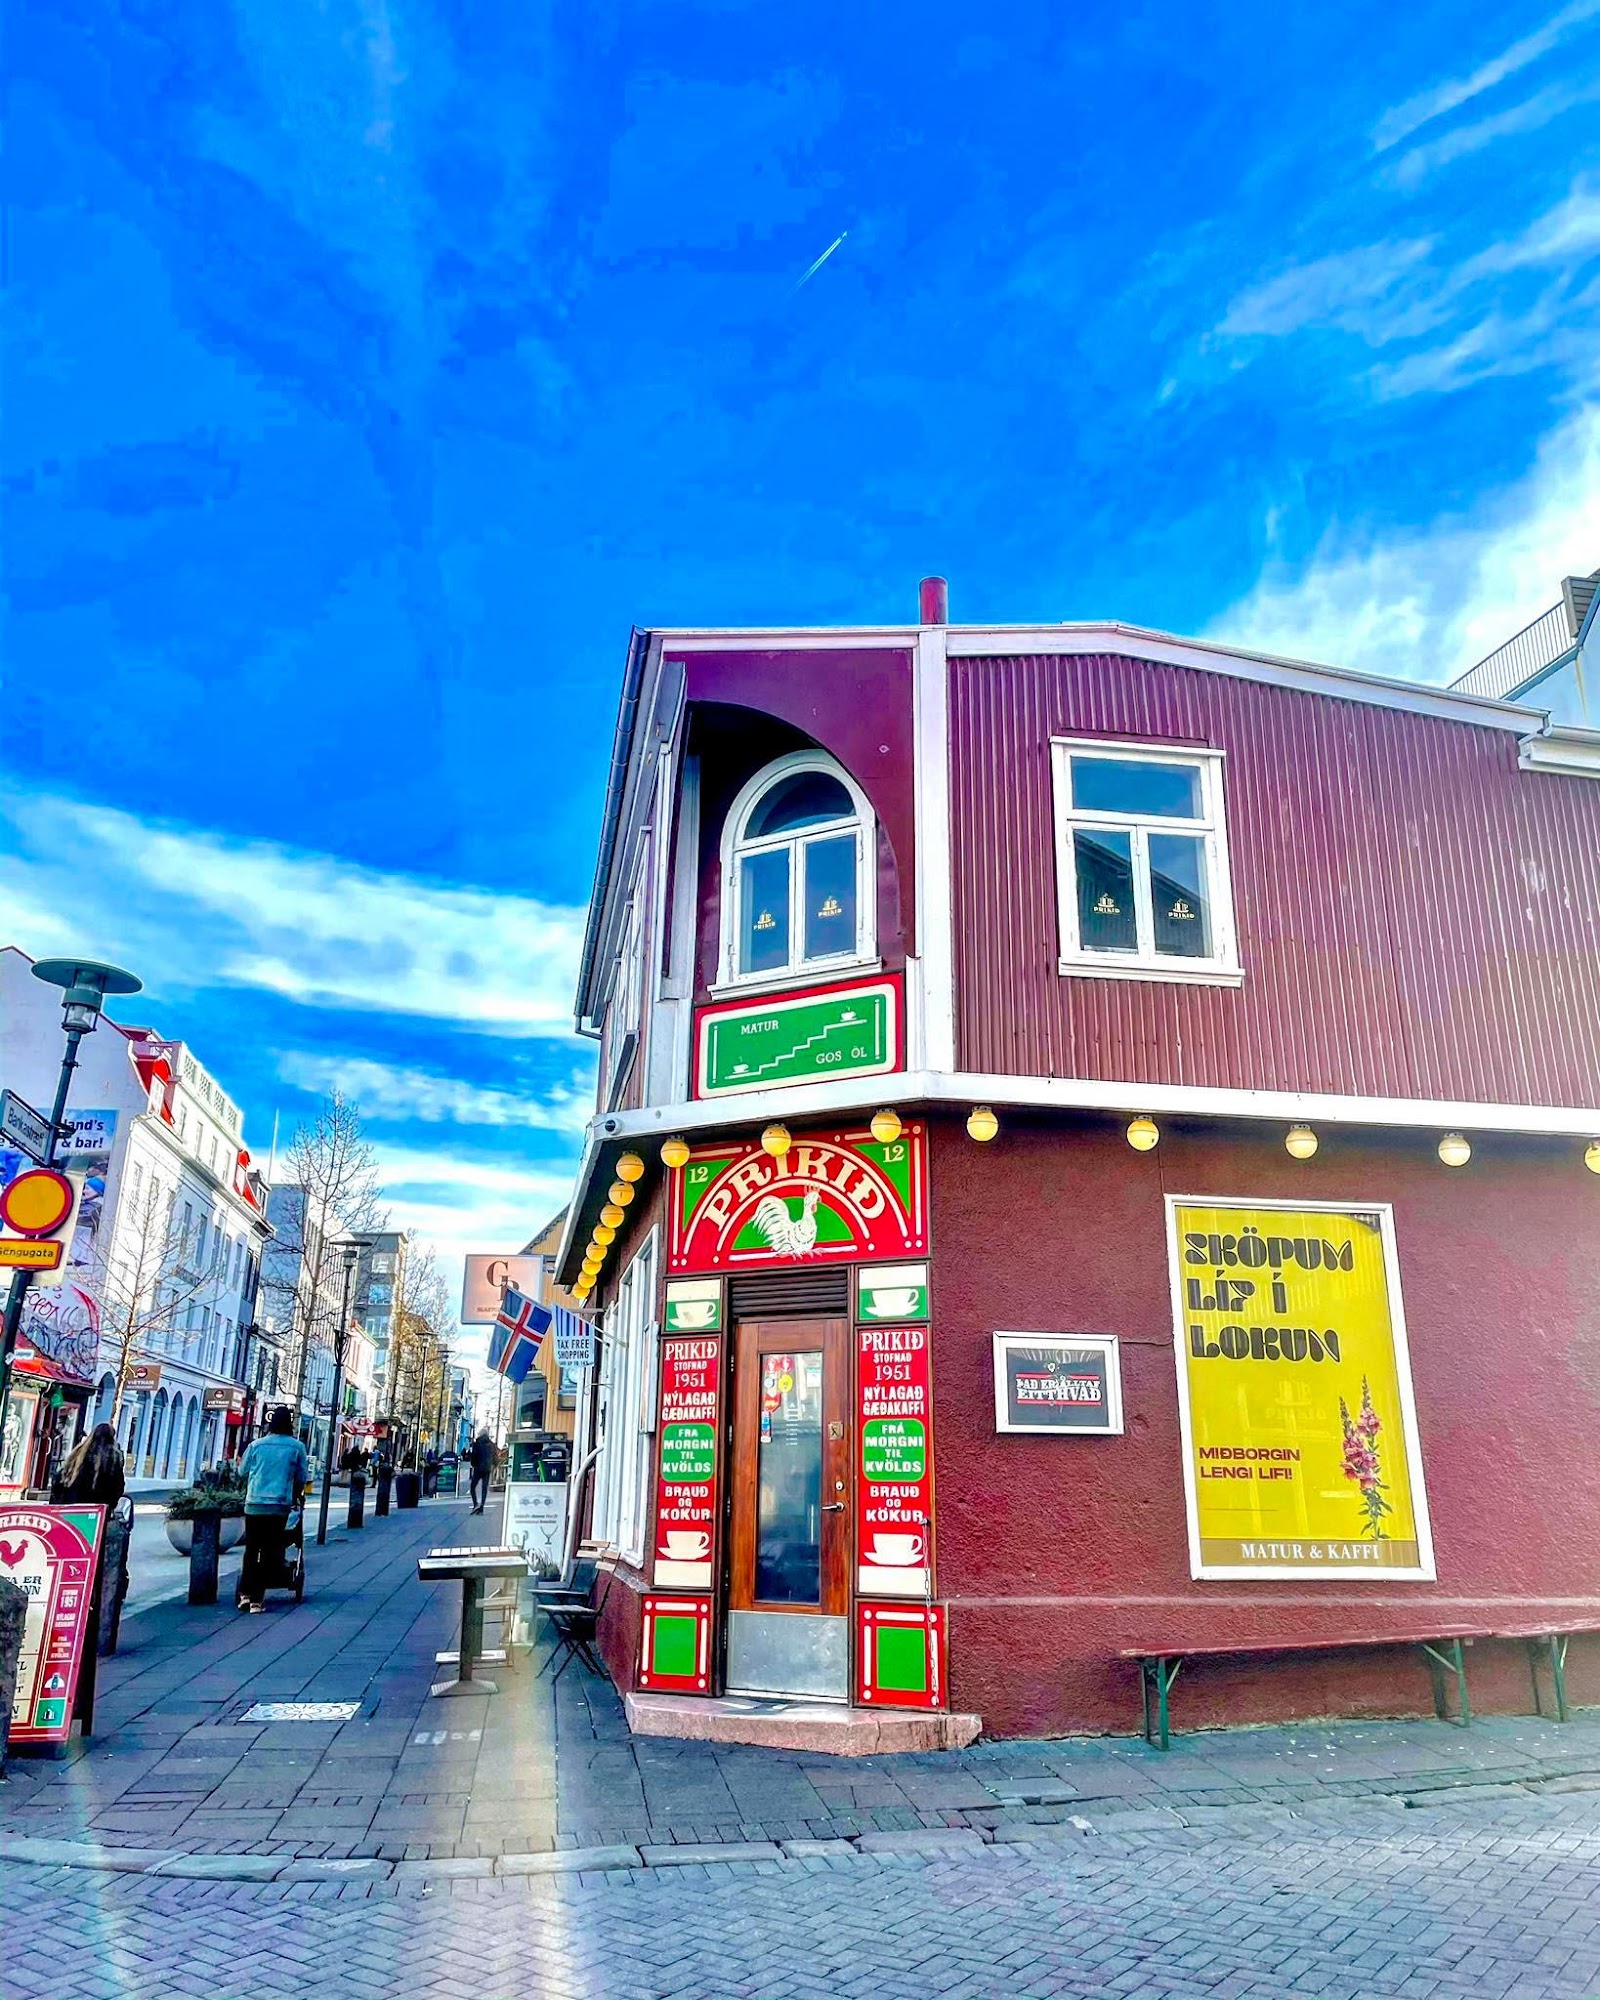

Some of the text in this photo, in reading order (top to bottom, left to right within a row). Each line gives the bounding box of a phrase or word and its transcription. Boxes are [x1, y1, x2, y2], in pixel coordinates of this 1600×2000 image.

[741, 1020, 779, 1035] MATUR
[816, 1051, 842, 1064] GOS
[61, 1137, 104, 1148] & bar!
[881, 1145, 905, 1163] 12
[688, 1166, 709, 1184] 12
[702, 1148, 886, 1231] PRIKIÐ
[1185, 1226, 1354, 1272] SKÖPUM
[557, 1339, 589, 1349] TAX FREE
[861, 1331, 924, 1351] PRIKIÐ
[1190, 1325, 1340, 1363] LOKUN
[558, 1350, 589, 1359] SHOPPING
[664, 1341, 718, 1360] PRIKIÐ
[875, 1364, 911, 1380] 1951
[675, 1373, 706, 1387] 1951
[663, 1390, 716, 1406] NÝLAGAÐ
[863, 1384, 924, 1401] NÝLAGAÐ
[862, 1400, 924, 1416] GÆÐAKAFFI
[881, 1422, 905, 1434] FRÁ
[663, 1439, 714, 1450] MORGNI
[865, 1436, 923, 1447] MORGNI
[680, 1450, 695, 1460] TIL
[884, 1448, 902, 1458] TIL
[1199, 1447, 1300, 1461] MIÐBORGIN
[662, 1460, 711, 1473] KVÖLDS
[865, 1459, 922, 1472] KVÖLDS
[1200, 1466, 1252, 1479] LENGI
[665, 1486, 709, 1498] BRAUÐ
[870, 1485, 920, 1498] BRAUÐ
[678, 1497, 692, 1508] OG
[886, 1498, 902, 1508] OG
[865, 1507, 924, 1522] KÖKUR
[1241, 1543, 1380, 1560] MATUR & KAFFI
[23, 1576, 42, 1585] ER
[61, 1596, 77, 1608] 1951
